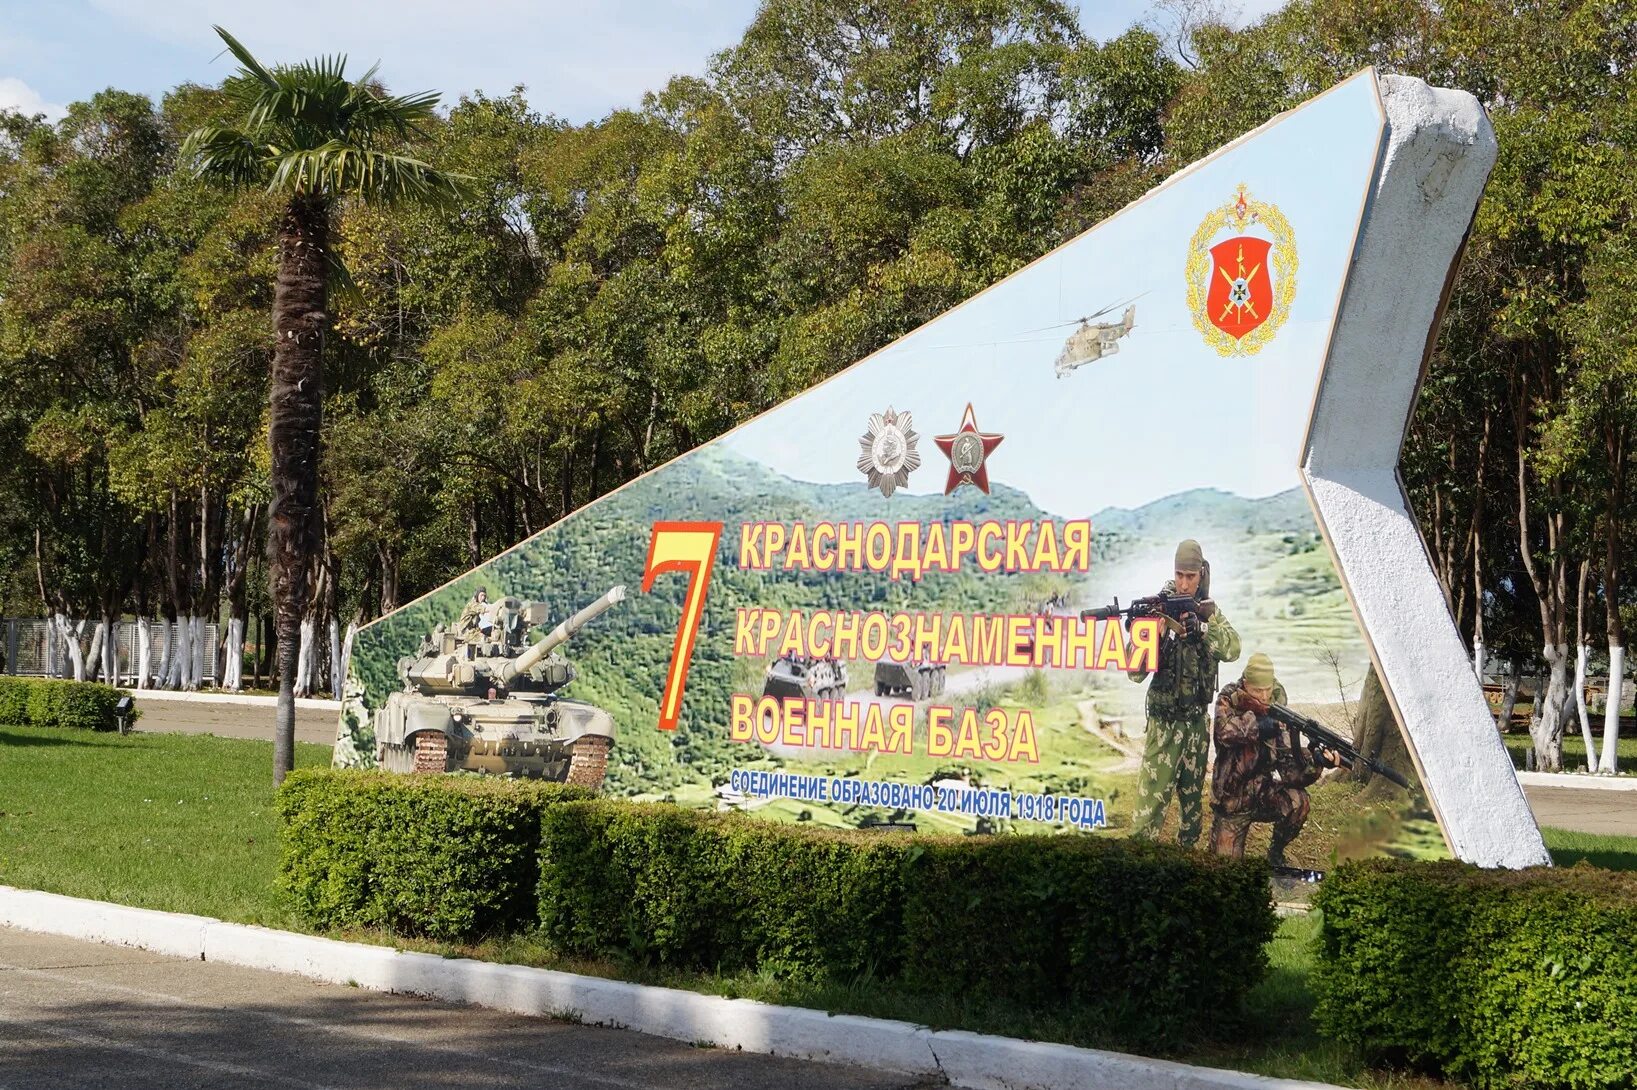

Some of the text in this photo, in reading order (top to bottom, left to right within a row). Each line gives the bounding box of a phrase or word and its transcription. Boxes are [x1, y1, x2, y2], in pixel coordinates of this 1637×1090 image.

[739, 519, 1092, 582] КРАСНОДАРСКАЯ
[641, 521, 724, 731] 7
[734, 608, 1161, 673] КРАСНОЗНАМЕННАЯ
[730, 695, 1040, 764] ВОЕННАЯ БАЗА
[730, 769, 1106, 829] СОЕДИНЕНИЕ ОБРАЗОВАНО 20 ИЮЛЯ 1918 ГОДА
